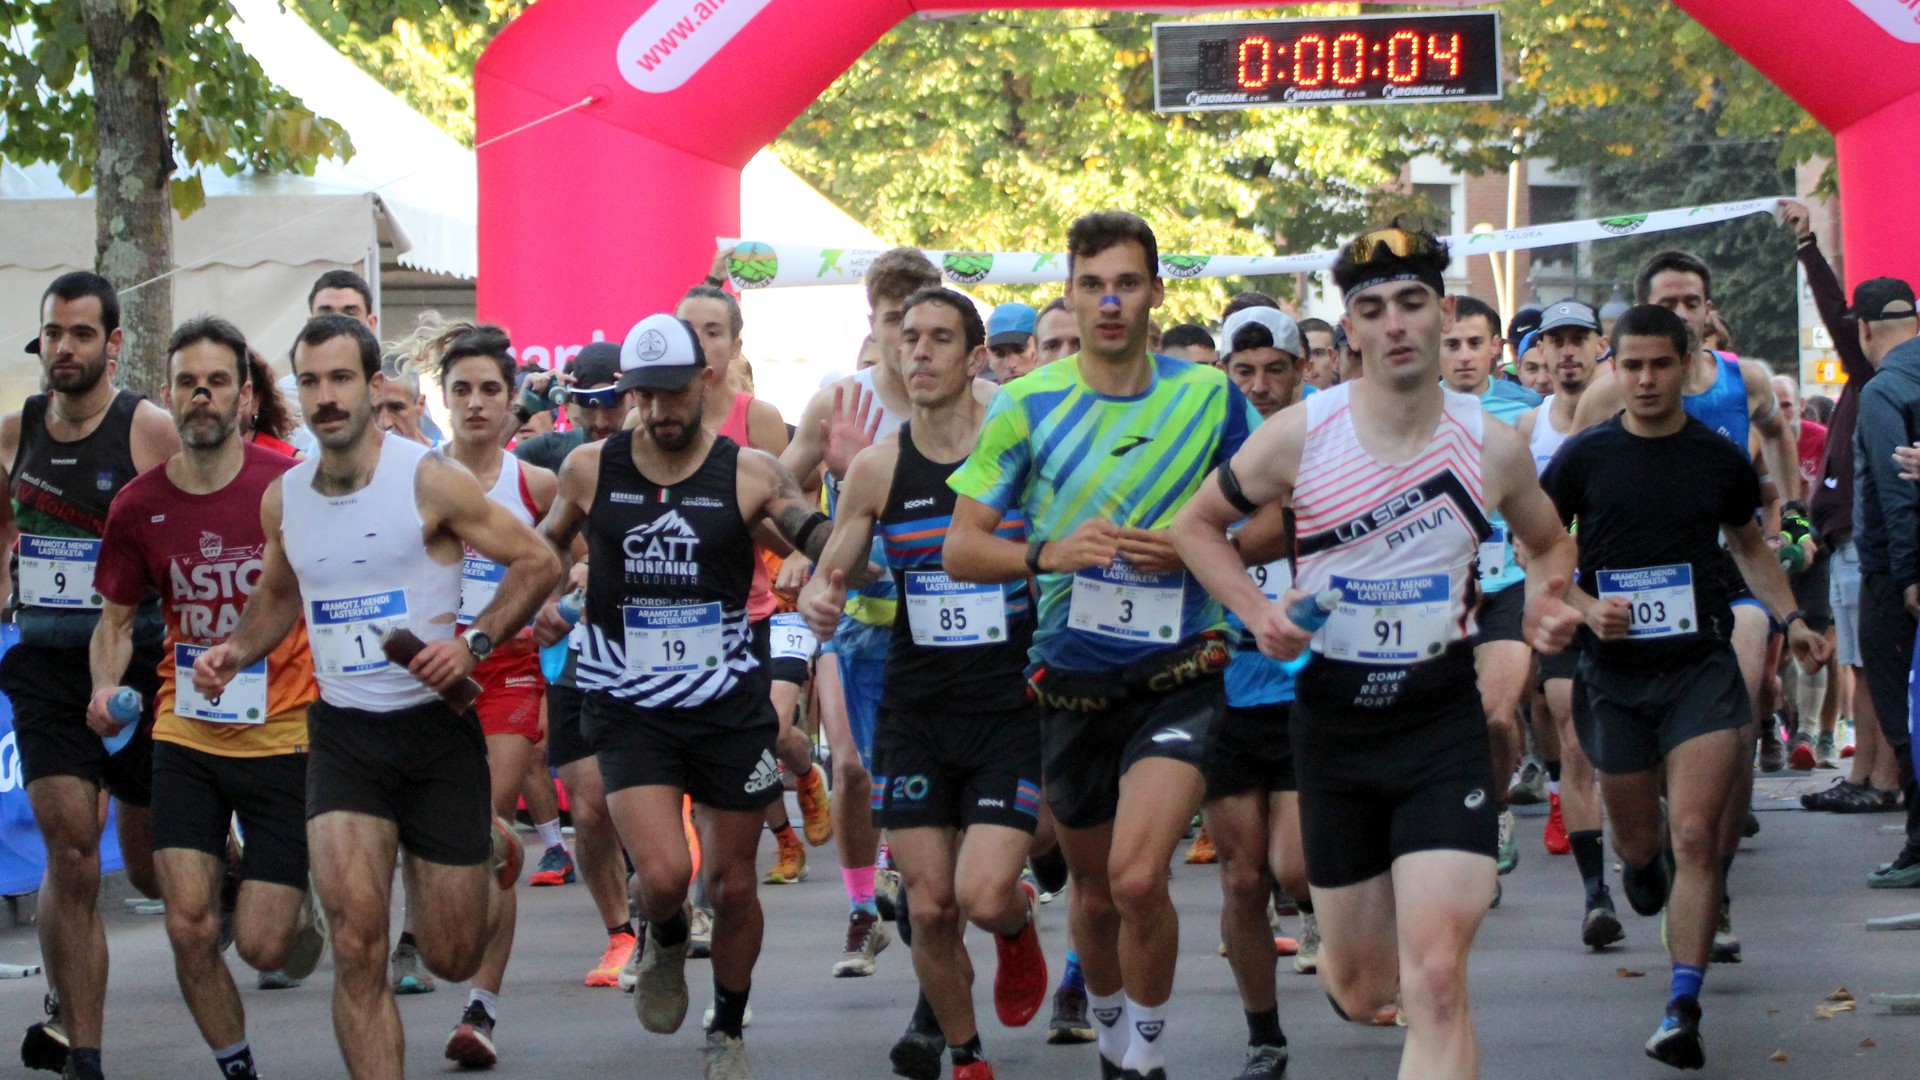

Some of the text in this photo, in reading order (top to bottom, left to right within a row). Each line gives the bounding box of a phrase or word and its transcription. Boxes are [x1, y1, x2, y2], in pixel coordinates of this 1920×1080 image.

[1237, 32, 1461, 88] 0:00:04
[1164, 262, 1206, 277] ARAMOTZ
[732, 275, 774, 290] ARAMOTZ
[946, 270, 987, 284] ARAMOTZ
[1371, 487, 1424, 528] SPO
[1334, 517, 1369, 543] LA
[30, 538, 93, 551] ARAMOTZ MENDI
[622, 534, 700, 562] CATT
[38, 547, 84, 558] LASTERKETA
[471, 561, 495, 571] MENDI
[624, 559, 699, 575] MORKAIKO
[624, 573, 698, 585] ELGOIBAR
[1102, 569, 1159, 583] LASTERKETA
[1610, 568, 1676, 581] ARAMOTZ MENDI
[54, 572, 66, 594] 9
[925, 583, 976, 591] LASTERKETA
[1345, 578, 1432, 592] ARAMOTZ MENDI
[1619, 577, 1668, 588] LASTERKETA
[1357, 590, 1421, 601] LASTERKETA
[321, 595, 390, 612] ARAMOTZ MENDI
[329, 606, 381, 619] LASTERKETA
[638, 607, 707, 618] ARAMOTZ MENDI
[1118, 599, 1133, 623] 3
[647, 616, 698, 625] LASTERKETA
[939, 607, 967, 631] 85
[1374, 619, 1402, 646] 91
[354, 635, 366, 659] 1
[787, 634, 803, 649] 97
[662, 639, 686, 662] 19
[1366, 670, 1407, 682] COMP
[1360, 683, 1398, 695] RESS
[1353, 696, 1395, 707] PORT
